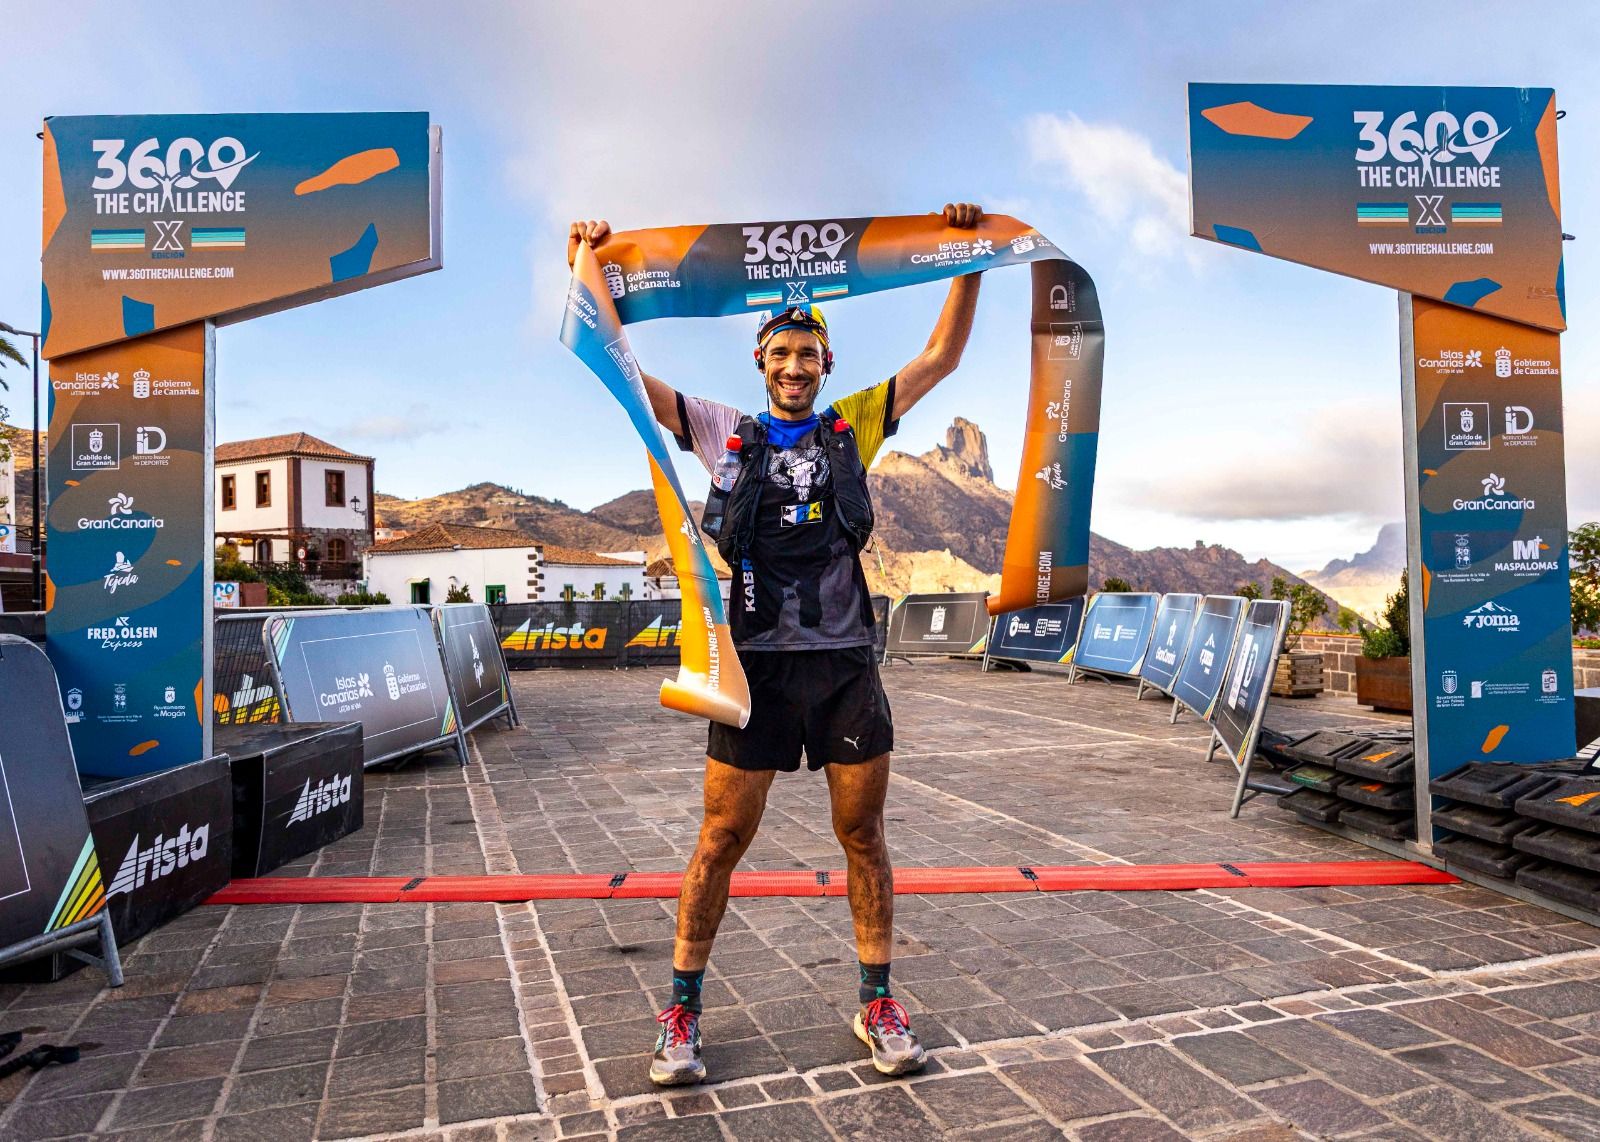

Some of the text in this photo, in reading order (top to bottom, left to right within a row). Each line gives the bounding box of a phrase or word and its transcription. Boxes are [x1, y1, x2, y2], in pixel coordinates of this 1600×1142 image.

[1357, 166, 1501, 188] THE CHALLENGE
[94, 191, 246, 214] THE CHALLENGE
[1415, 195, 1446, 226] X
[153, 220, 185, 251] X
[938, 241, 970, 252] Islas
[1369, 243, 1494, 255] WWW.360THECHALLENGE.COM
[911, 250, 971, 264] Canarias
[102, 267, 235, 281] WWW.360THECHALLENGE.COM
[626, 270, 670, 282] Gobierno
[745, 260, 847, 280] THE CHALLENGE
[628, 279, 681, 292] de Canarias
[786, 281, 808, 300] X
[567, 300, 597, 329] anarias
[1440, 350, 1463, 359] Islas
[1419, 358, 1464, 367] Canarias
[1514, 359, 1550, 367] Gobierno
[75, 372, 100, 381] Islas
[1514, 367, 1559, 375] de Canarias
[53, 381, 100, 390] Canarias
[152, 388, 200, 396] de Canarias
[1058, 379, 1072, 443] GranCanaria
[1453, 498, 1535, 511] GranCanaria
[77, 516, 164, 529] GranCanaria
[1494, 561, 1559, 571] MASPALOMAS
[104, 573, 139, 594] Tejeda
[88, 627, 158, 639] FRED. OLSEN
[501, 618, 608, 651] Arista
[101, 637, 143, 651] Express
[336, 676, 356, 690] Islas
[397, 673, 420, 683] Gobierno
[400, 681, 427, 694] de Canarias
[320, 689, 359, 706] Canarias
[160, 709, 185, 718] Mogán
[286, 773, 352, 828] Arista
[105, 822, 210, 901] Arista
